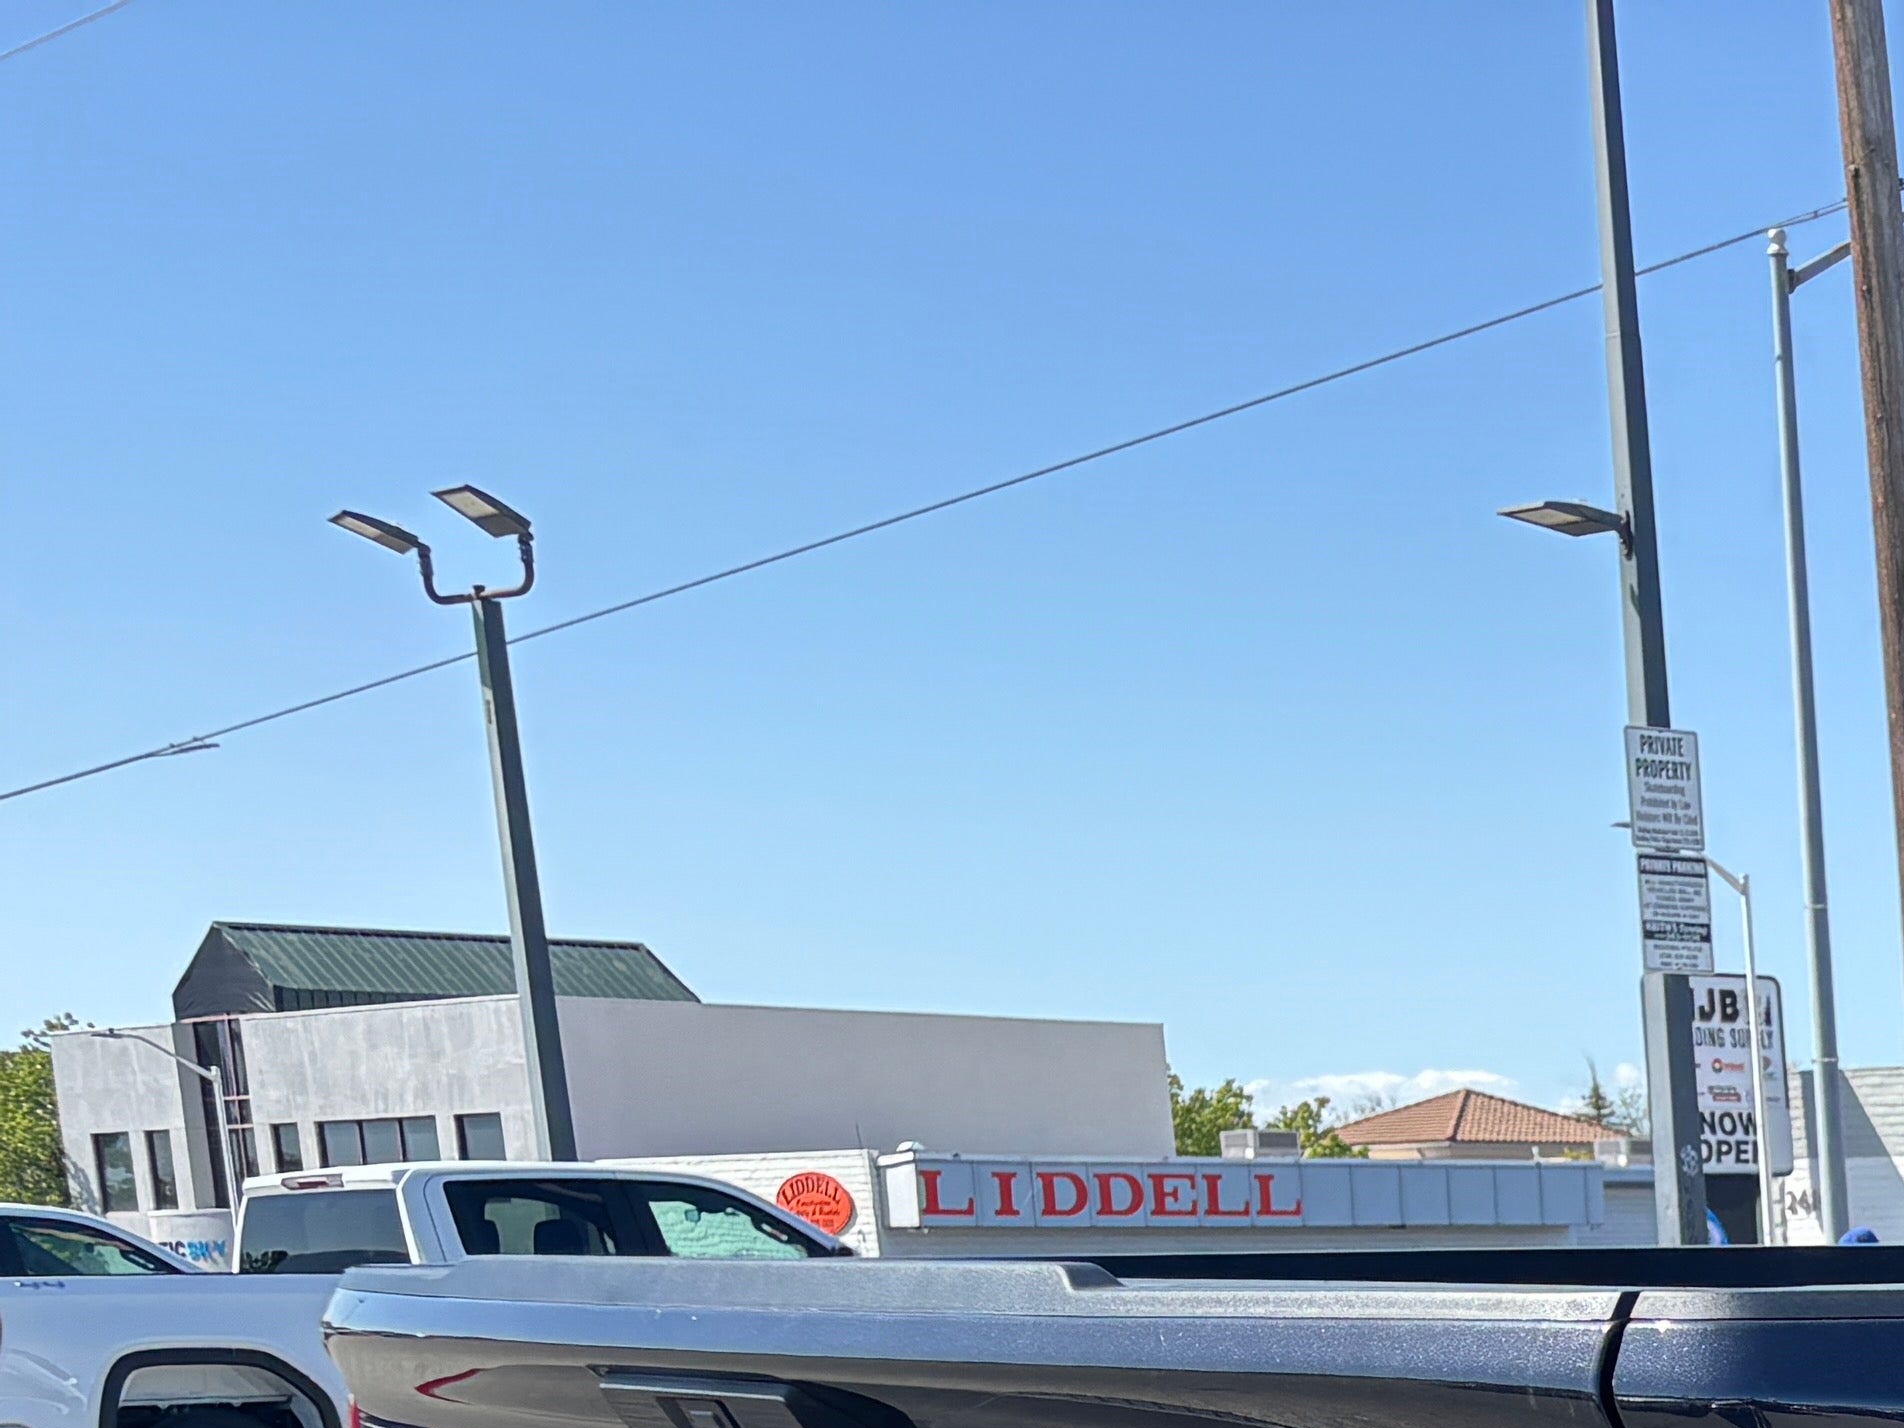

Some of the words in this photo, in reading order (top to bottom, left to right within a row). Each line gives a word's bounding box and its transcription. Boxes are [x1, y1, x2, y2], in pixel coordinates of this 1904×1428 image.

[1640, 734, 1684, 757] PRIVATE
[1635, 757, 1692, 781] PROPERTY
[1701, 1111, 1757, 1137] NOW
[781, 1175, 842, 1206] LIDDELL
[918, 1169, 1302, 1218] LIDDELL
